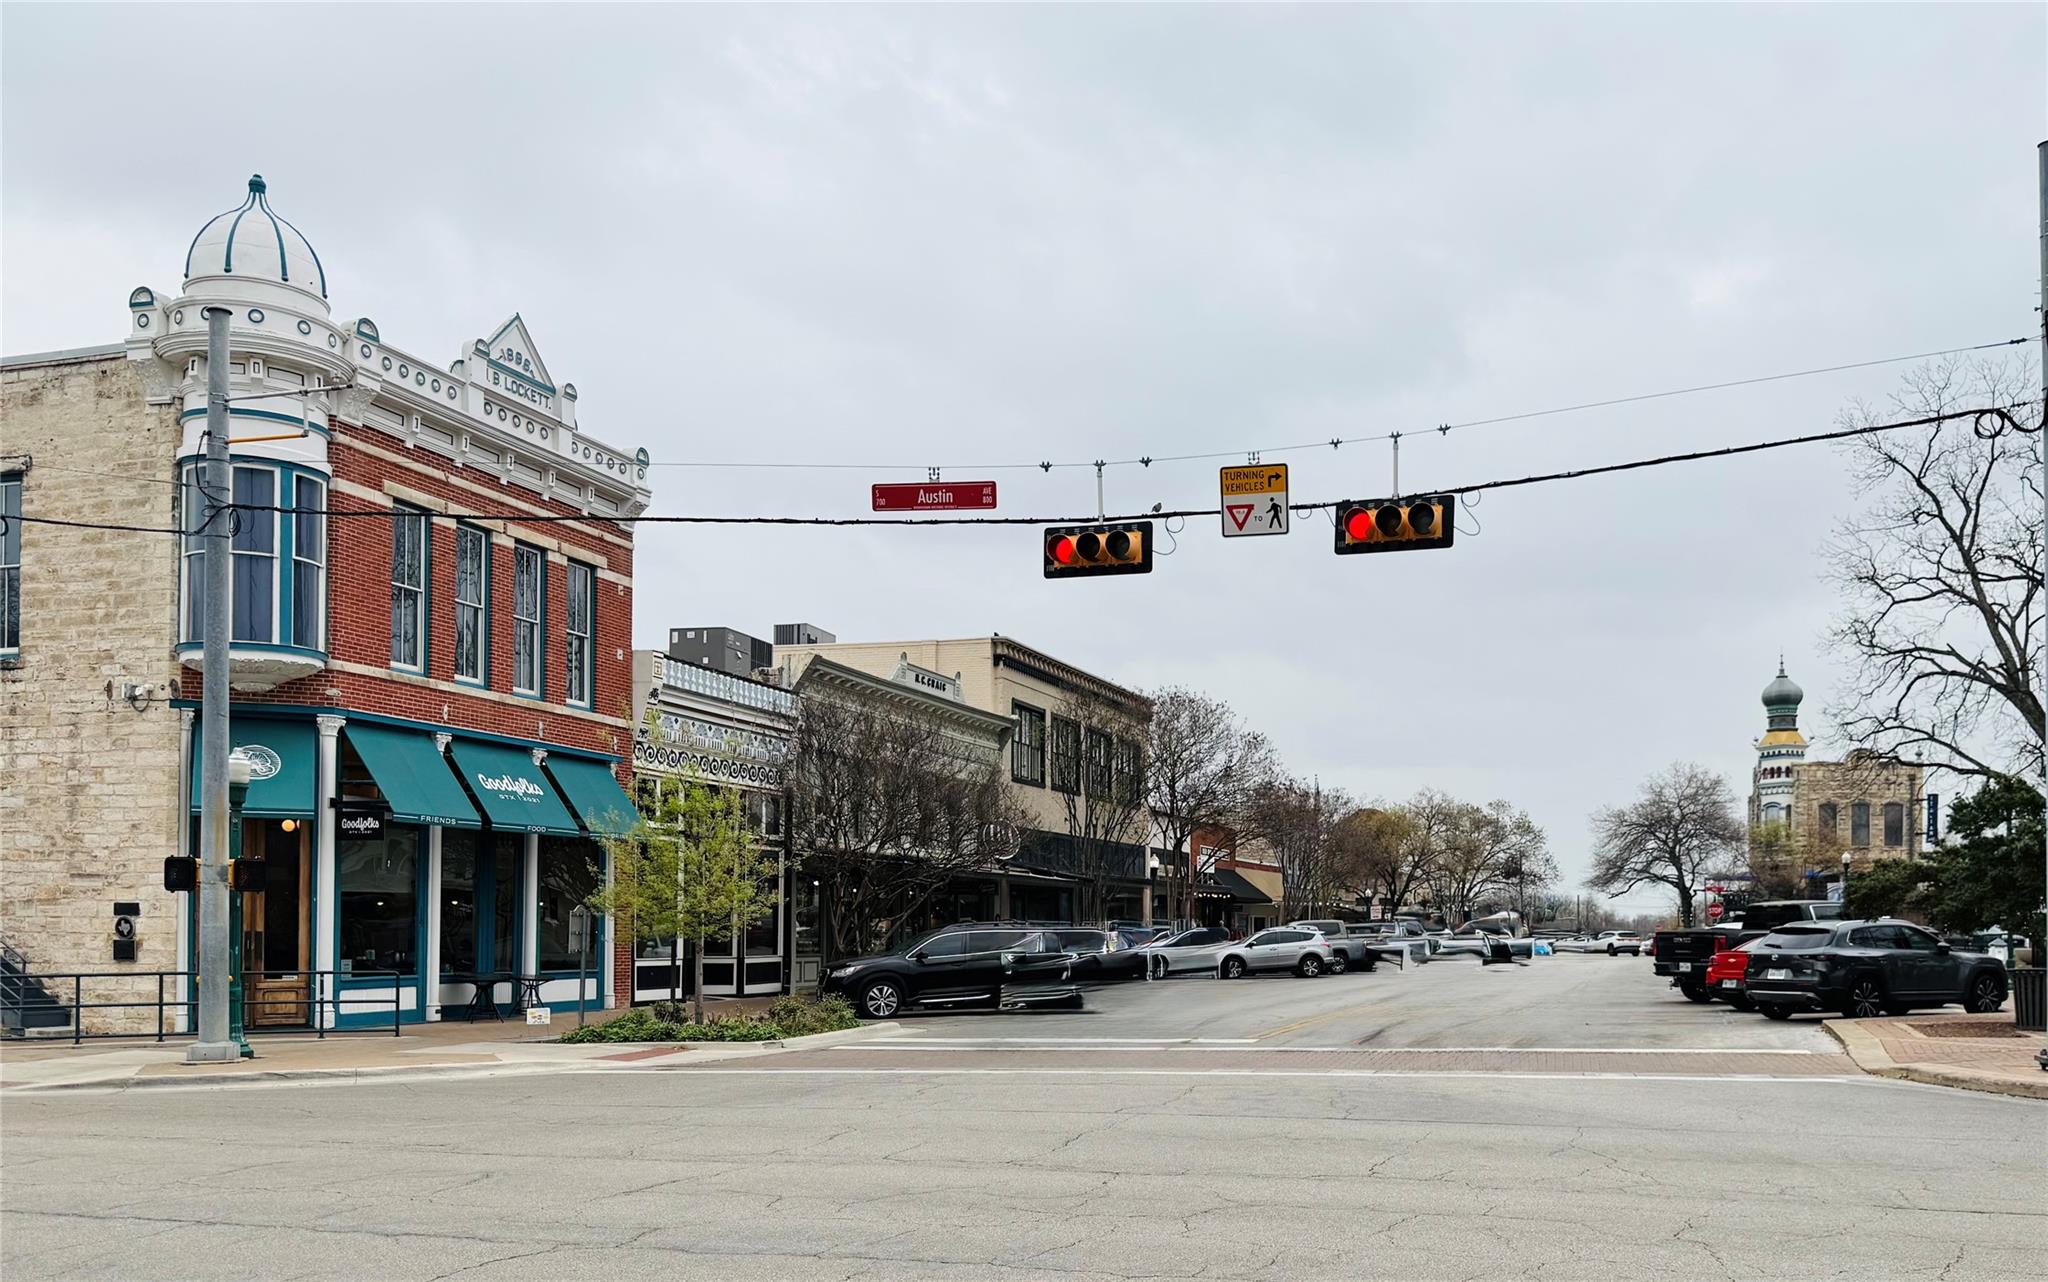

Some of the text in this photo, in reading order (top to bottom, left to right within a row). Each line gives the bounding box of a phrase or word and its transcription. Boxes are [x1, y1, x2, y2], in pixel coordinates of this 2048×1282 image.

[1224, 470, 1265, 481] TURNING
[1225, 481, 1265, 492] VEHICLES
[917, 488, 954, 504] Austin
[982, 486, 992, 495] AVE
[477, 773, 544, 796] Goodfolks
[341, 816, 380, 831] Goodfolks
[420, 815, 457, 825] FRIENDS
[527, 825, 547, 833] FOOD
